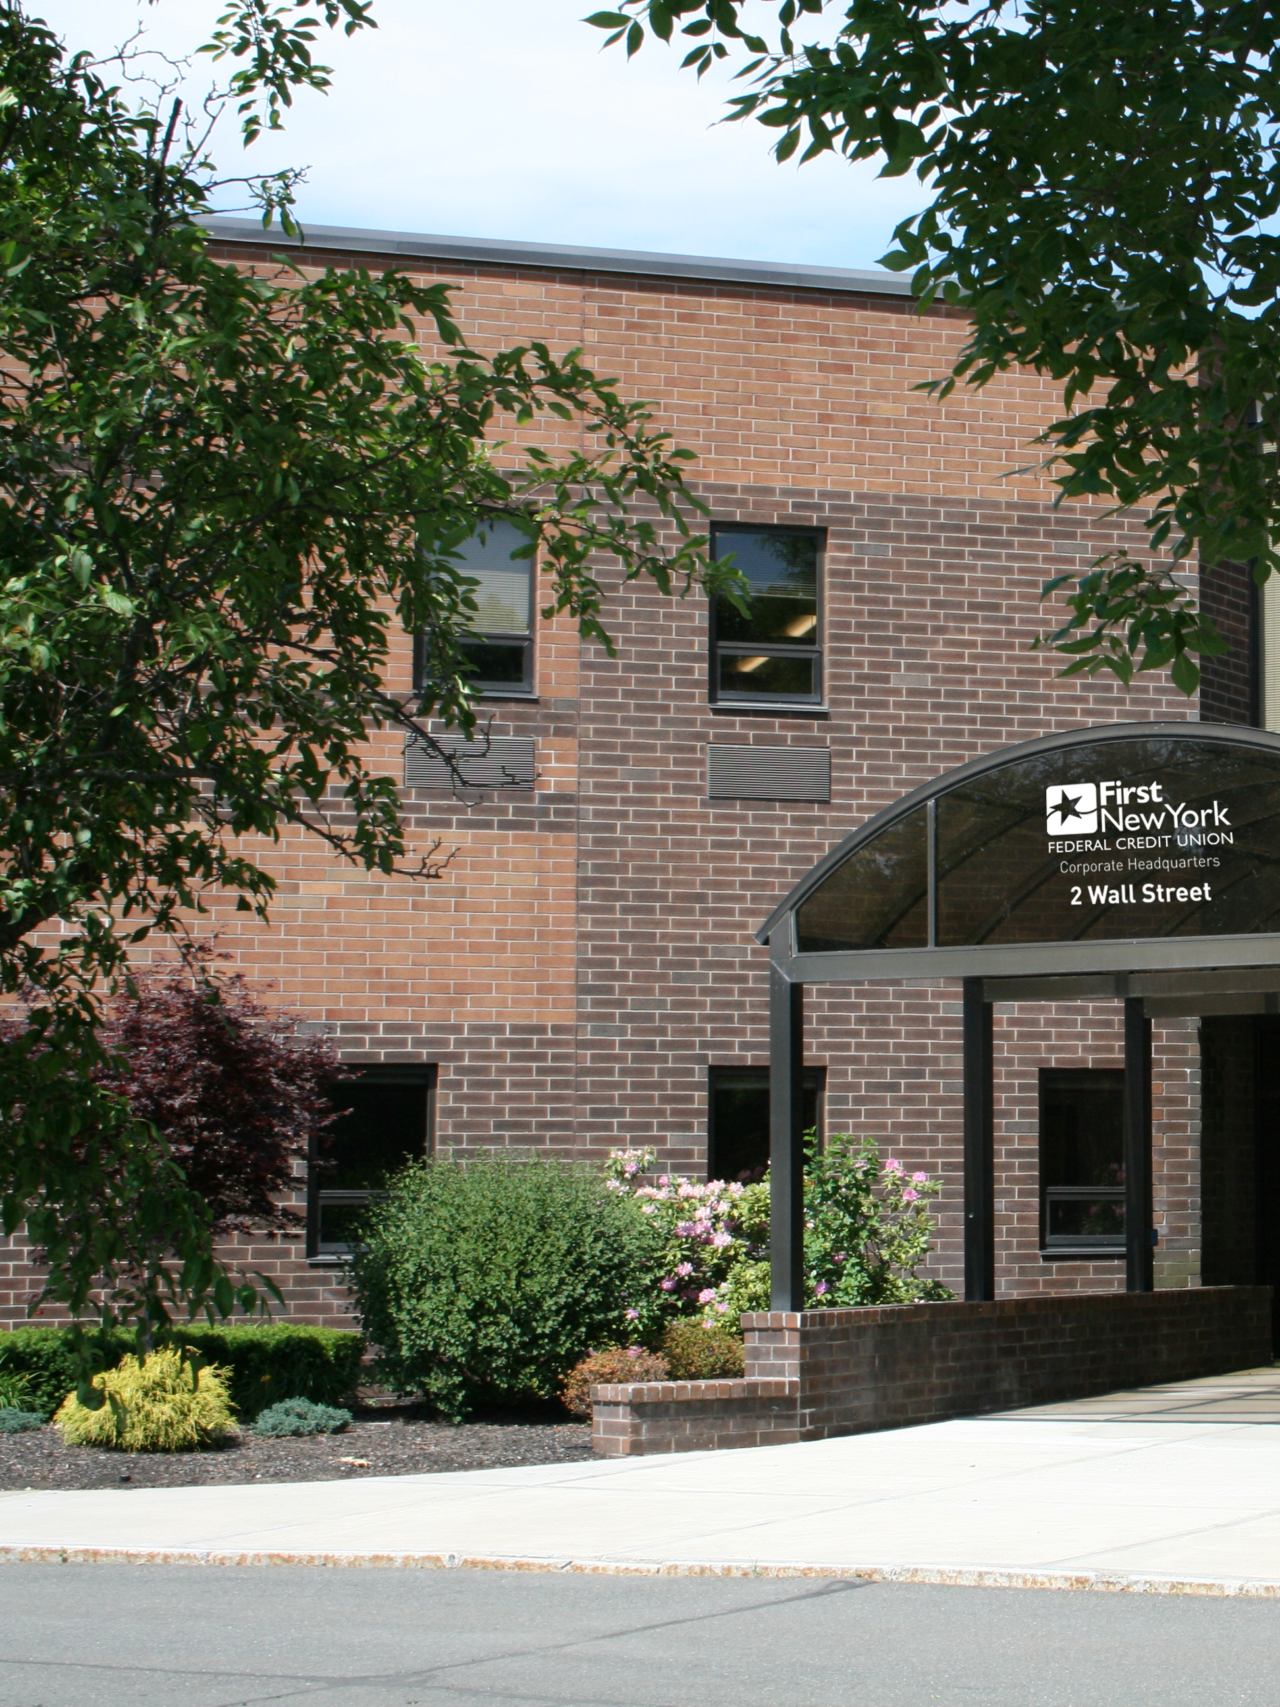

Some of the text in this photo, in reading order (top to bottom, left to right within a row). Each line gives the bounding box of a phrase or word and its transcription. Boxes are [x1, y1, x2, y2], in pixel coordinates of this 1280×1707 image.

[1099, 780, 1163, 806] First
[1048, 831, 1234, 854] FEDERAL CREDIT UNION
[1060, 856, 1221, 876] Corporate Headquarters
[1070, 882, 1212, 906] 2 Wall Street
